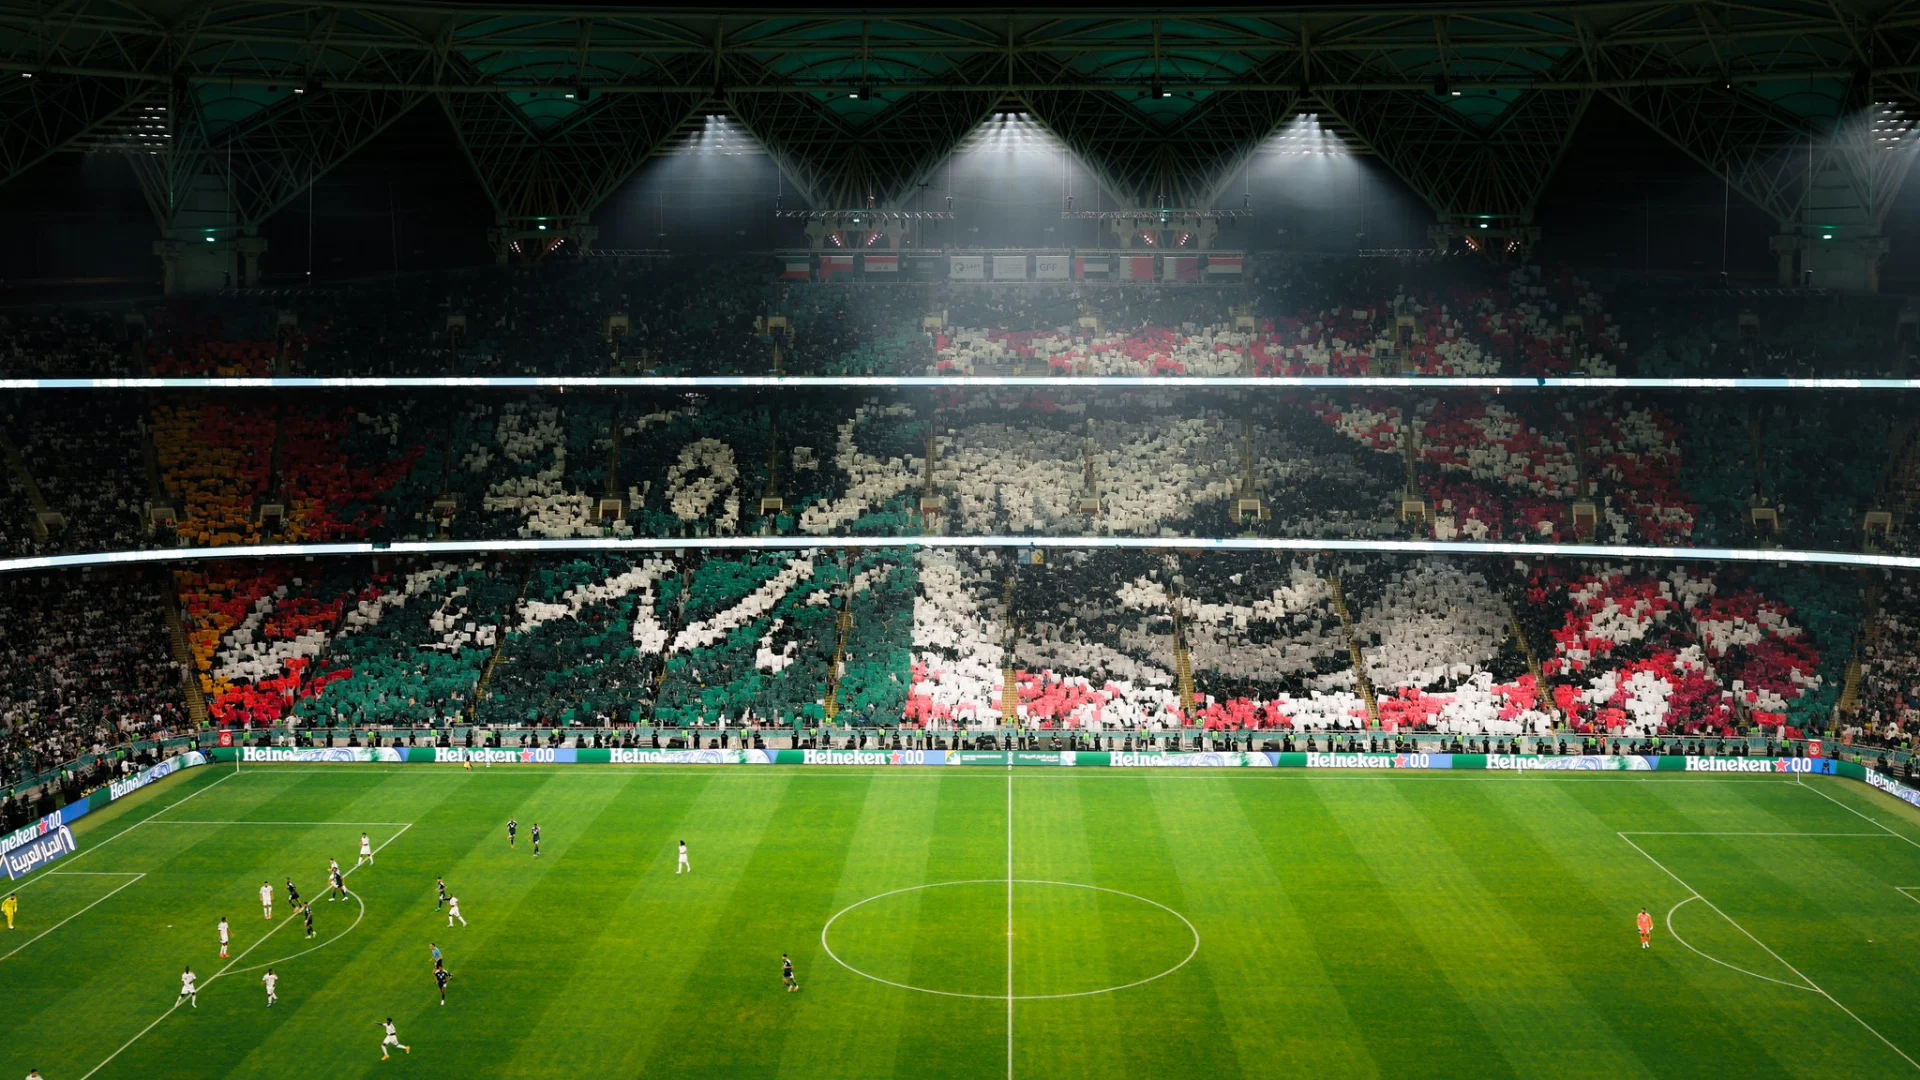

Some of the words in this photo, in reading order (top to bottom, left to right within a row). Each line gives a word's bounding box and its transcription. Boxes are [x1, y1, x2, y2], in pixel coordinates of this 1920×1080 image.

[434, 747, 517, 762] Heineken
[802, 749, 886, 764] Heineken
[1306, 752, 1390, 768] Heineken
[1685, 756, 1771, 772] Heineken
